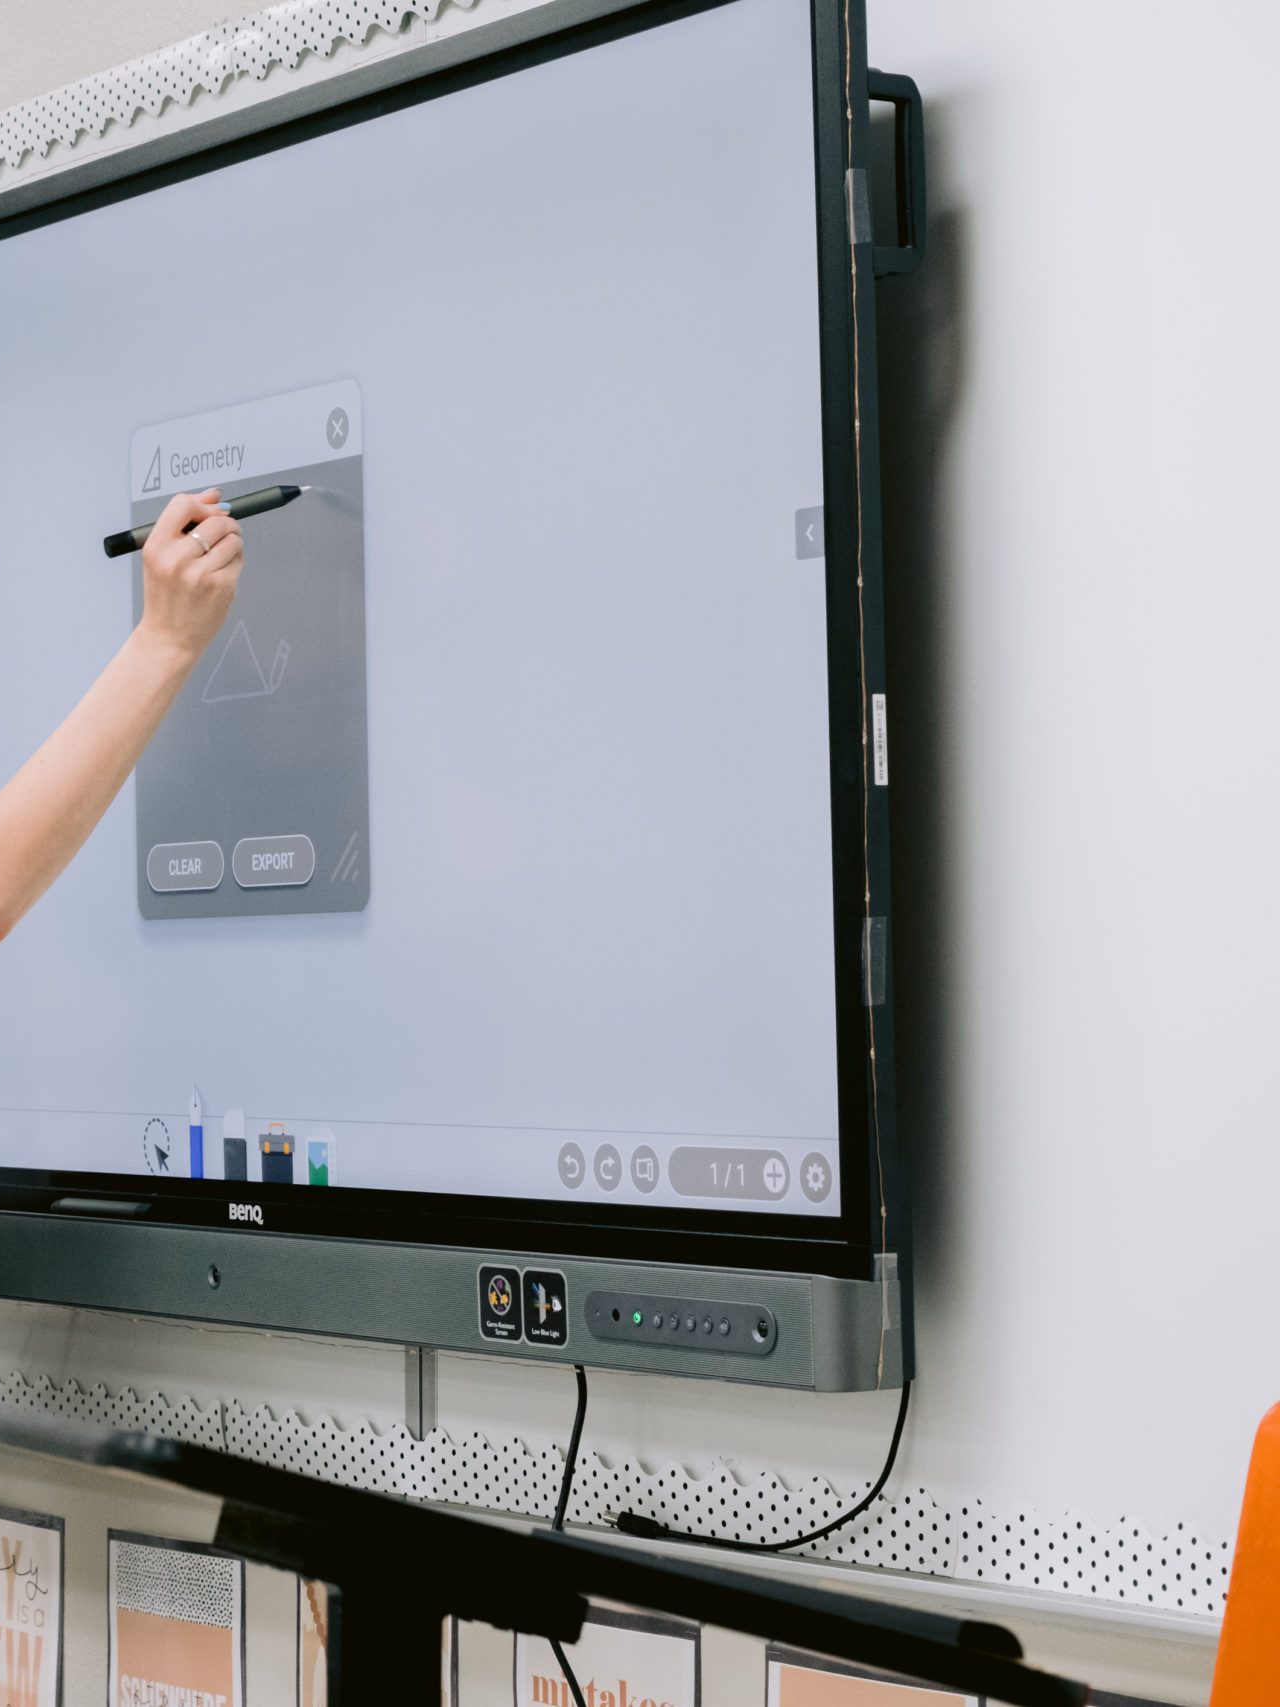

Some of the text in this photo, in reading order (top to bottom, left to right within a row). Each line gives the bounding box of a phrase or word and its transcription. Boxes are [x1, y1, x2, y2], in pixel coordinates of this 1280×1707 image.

[170, 443, 245, 478] Geometry
[169, 858, 202, 876] CLEAR
[252, 852, 295, 871] EXPORT
[229, 1203, 264, 1225] BenQ
[540, 1328, 549, 1337] Blue
[550, 1330, 560, 1339] Light
[34, 1609, 45, 1628] a
[532, 1671, 674, 1707] mitak
